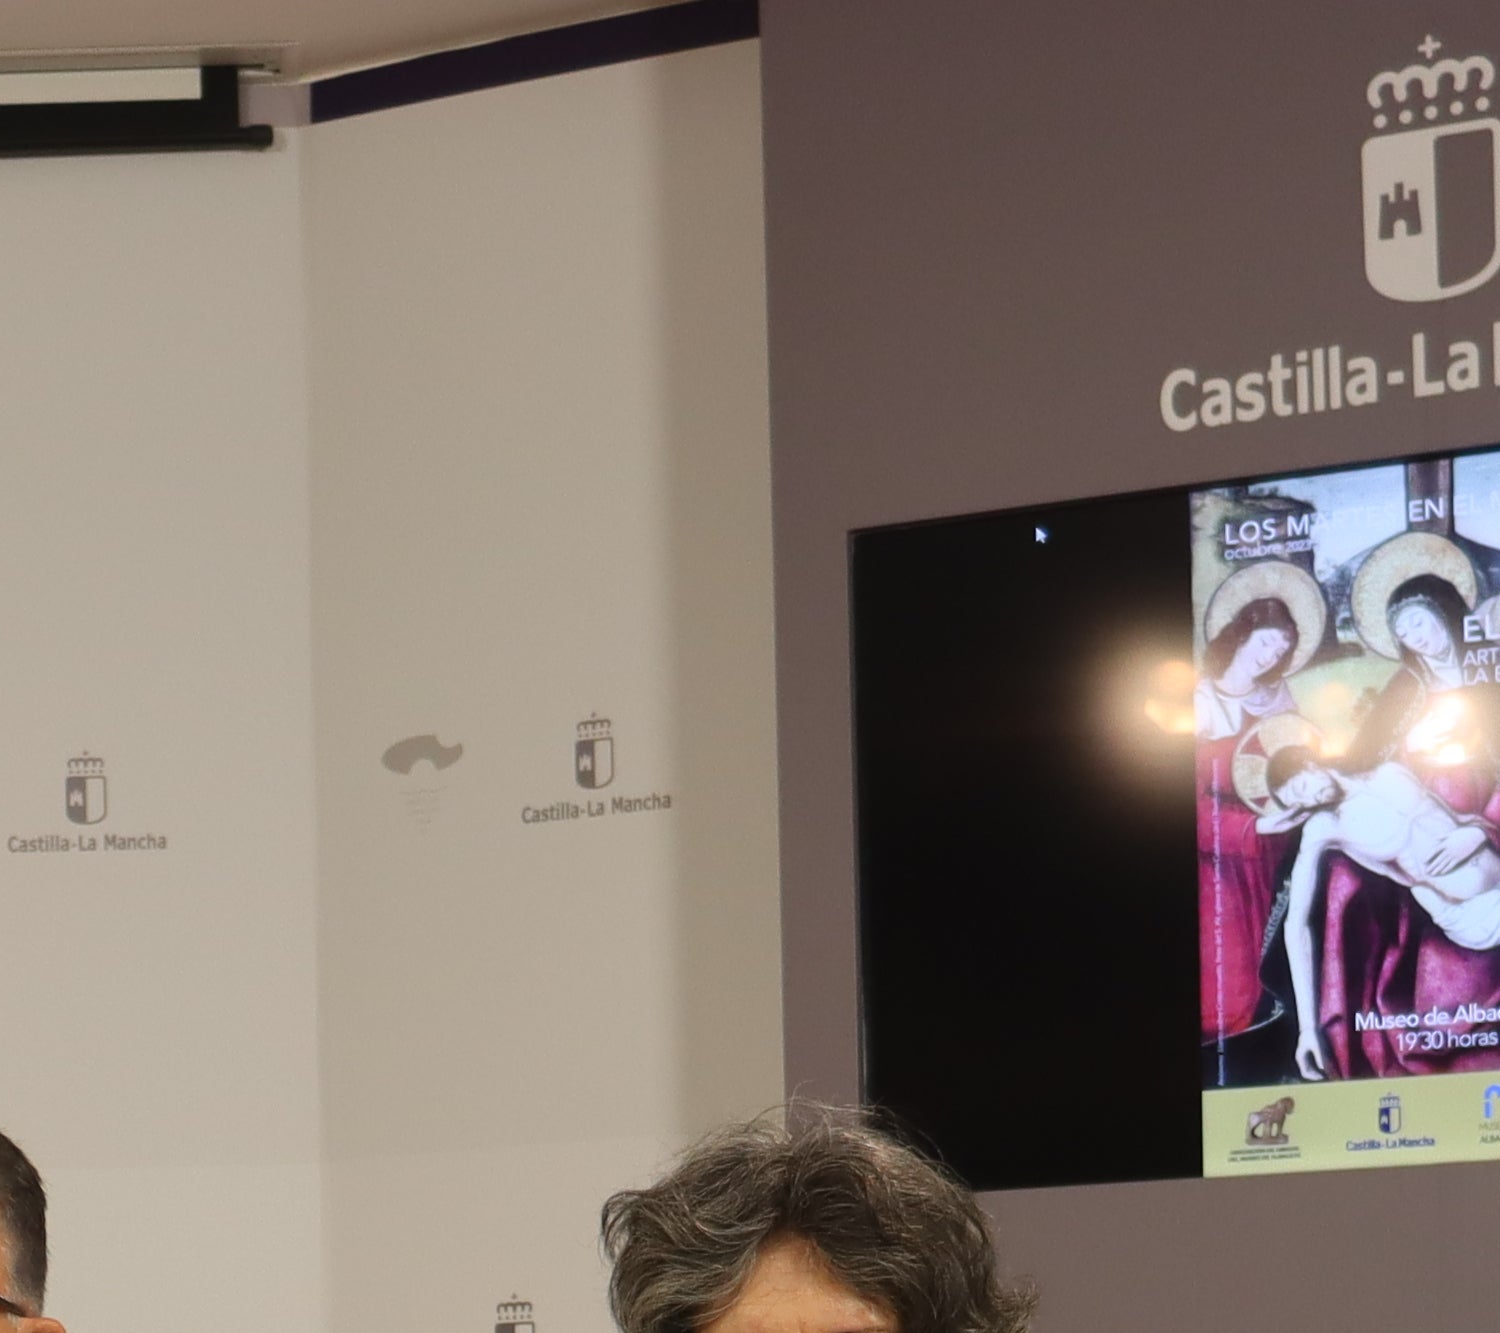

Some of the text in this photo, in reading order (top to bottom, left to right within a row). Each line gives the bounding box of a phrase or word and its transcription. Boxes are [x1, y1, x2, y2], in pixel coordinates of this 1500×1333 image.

[1159, 331, 1481, 433] Castilla-La
[1224, 517, 1277, 546] LOS
[1408, 497, 1445, 523] EN
[1463, 666, 1489, 686] LA
[521, 791, 673, 824] Castilla-La Mancha
[7, 832, 168, 853] Castilla-La Mancha
[1354, 1011, 1420, 1032] Museo
[1423, 1005, 1451, 1026] de
[1447, 1028, 1499, 1048] horas
